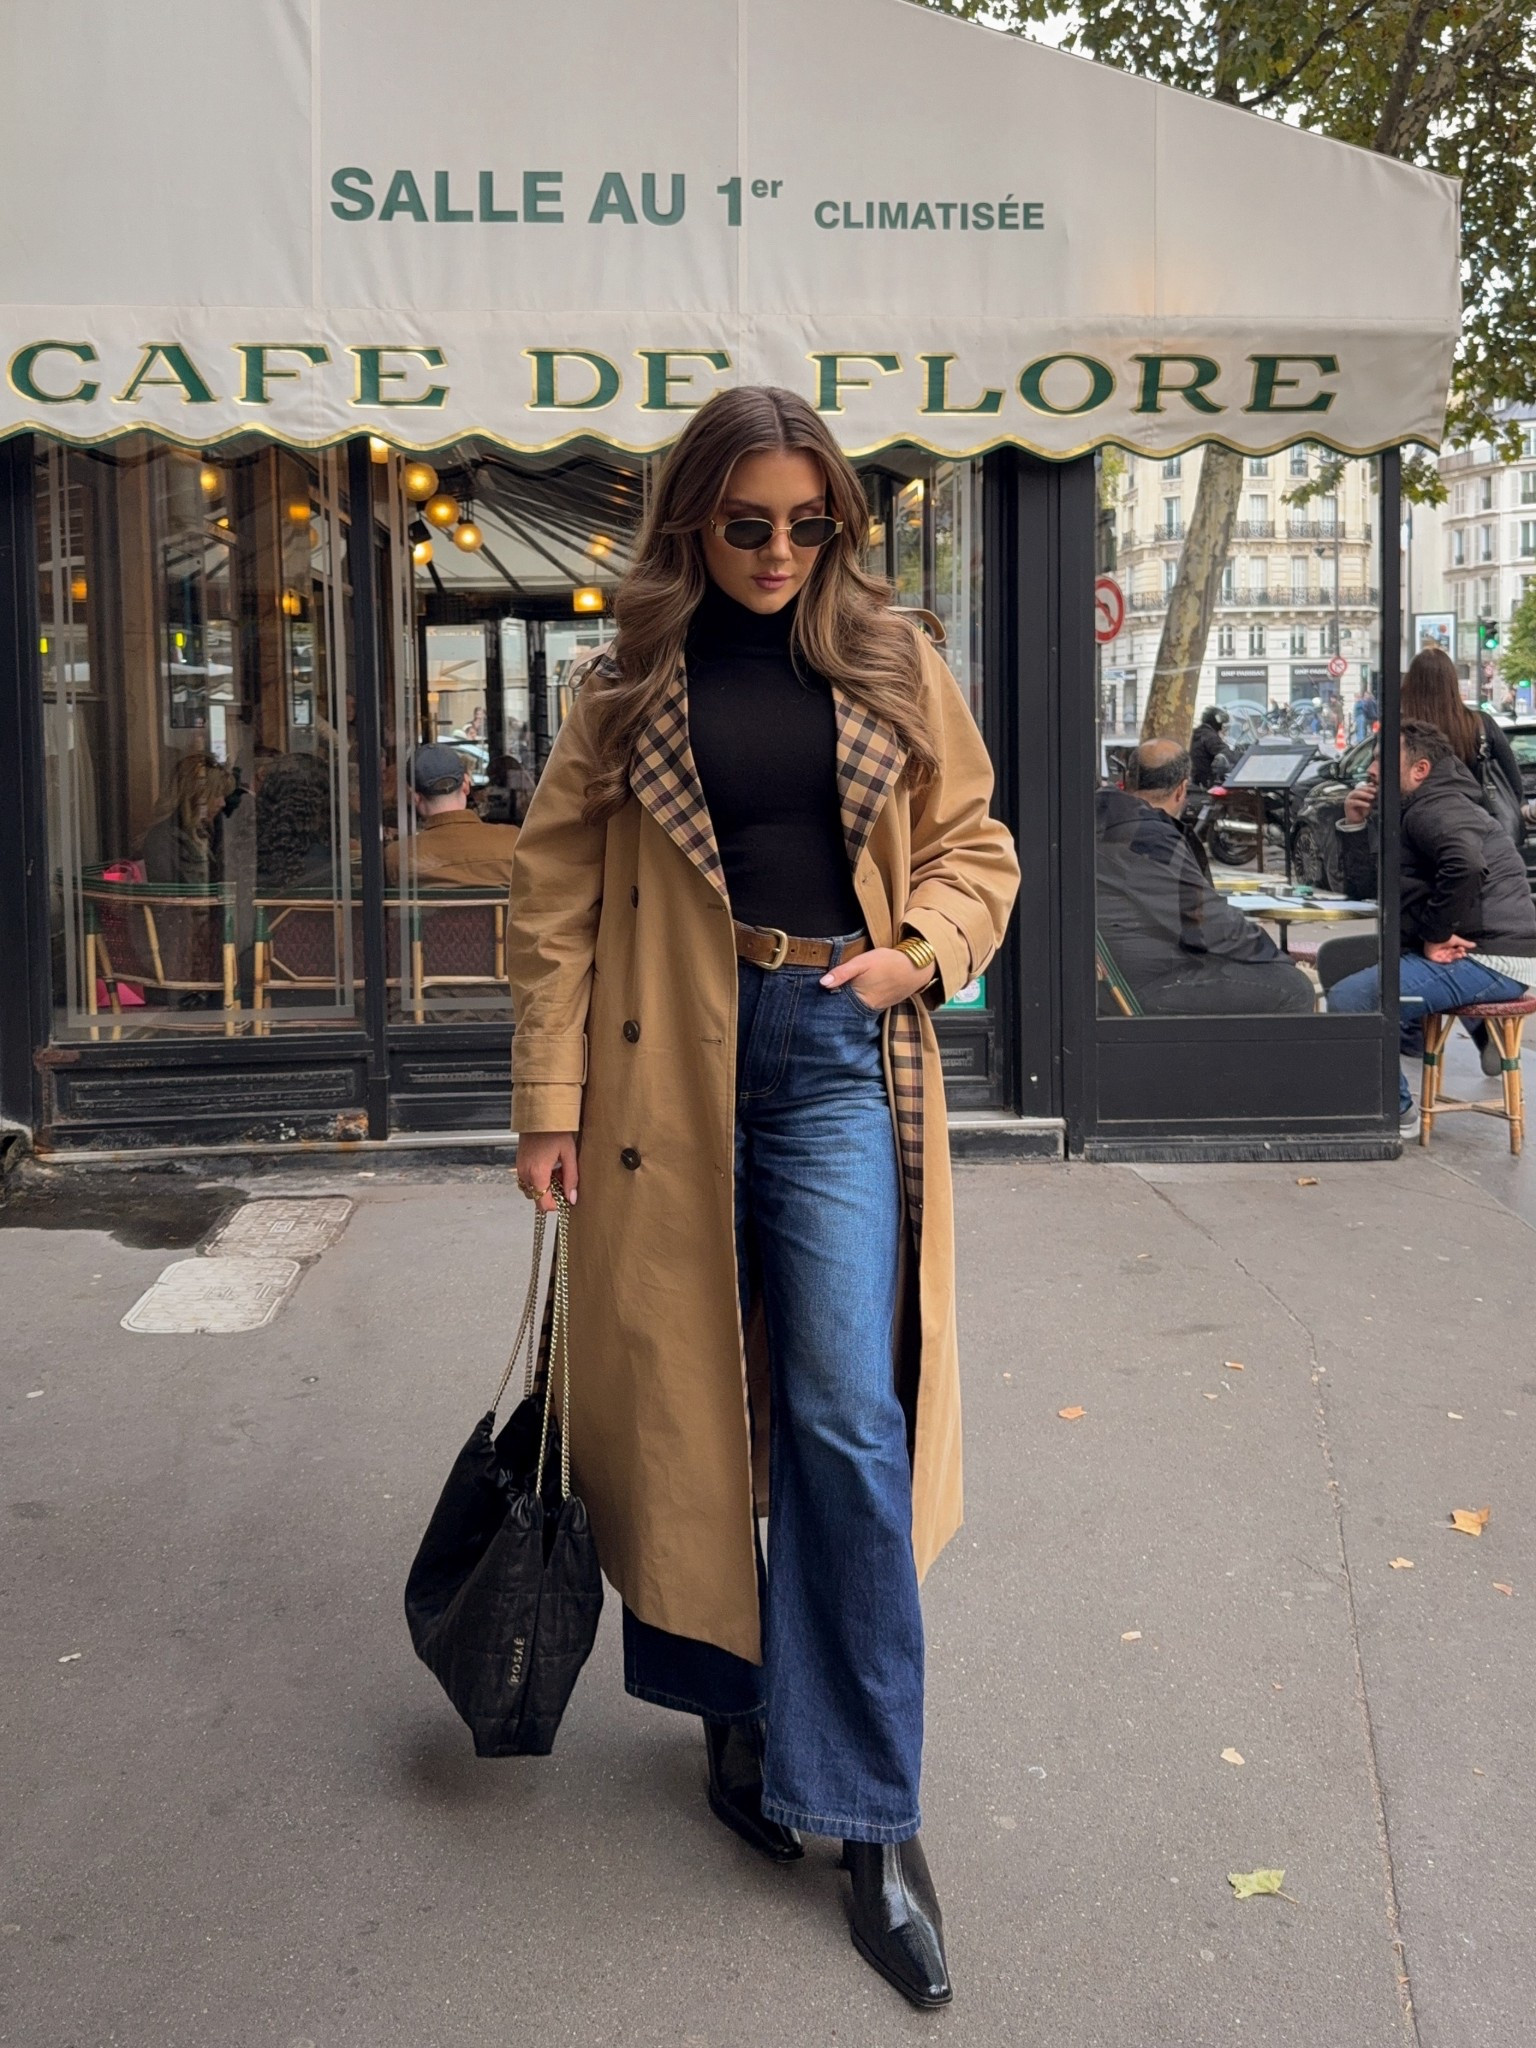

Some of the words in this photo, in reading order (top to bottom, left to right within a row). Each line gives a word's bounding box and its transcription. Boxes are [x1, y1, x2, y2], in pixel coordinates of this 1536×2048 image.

[330, 166, 564, 223] SALLE
[588, 171, 686, 226] AU
[716, 177, 783, 227] 1er
[814, 193, 1045, 231] CLIMATISÉE
[6, 339, 450, 411] CAFE
[520, 347, 733, 414] DE
[805, 350, 1342, 418] FLORE
